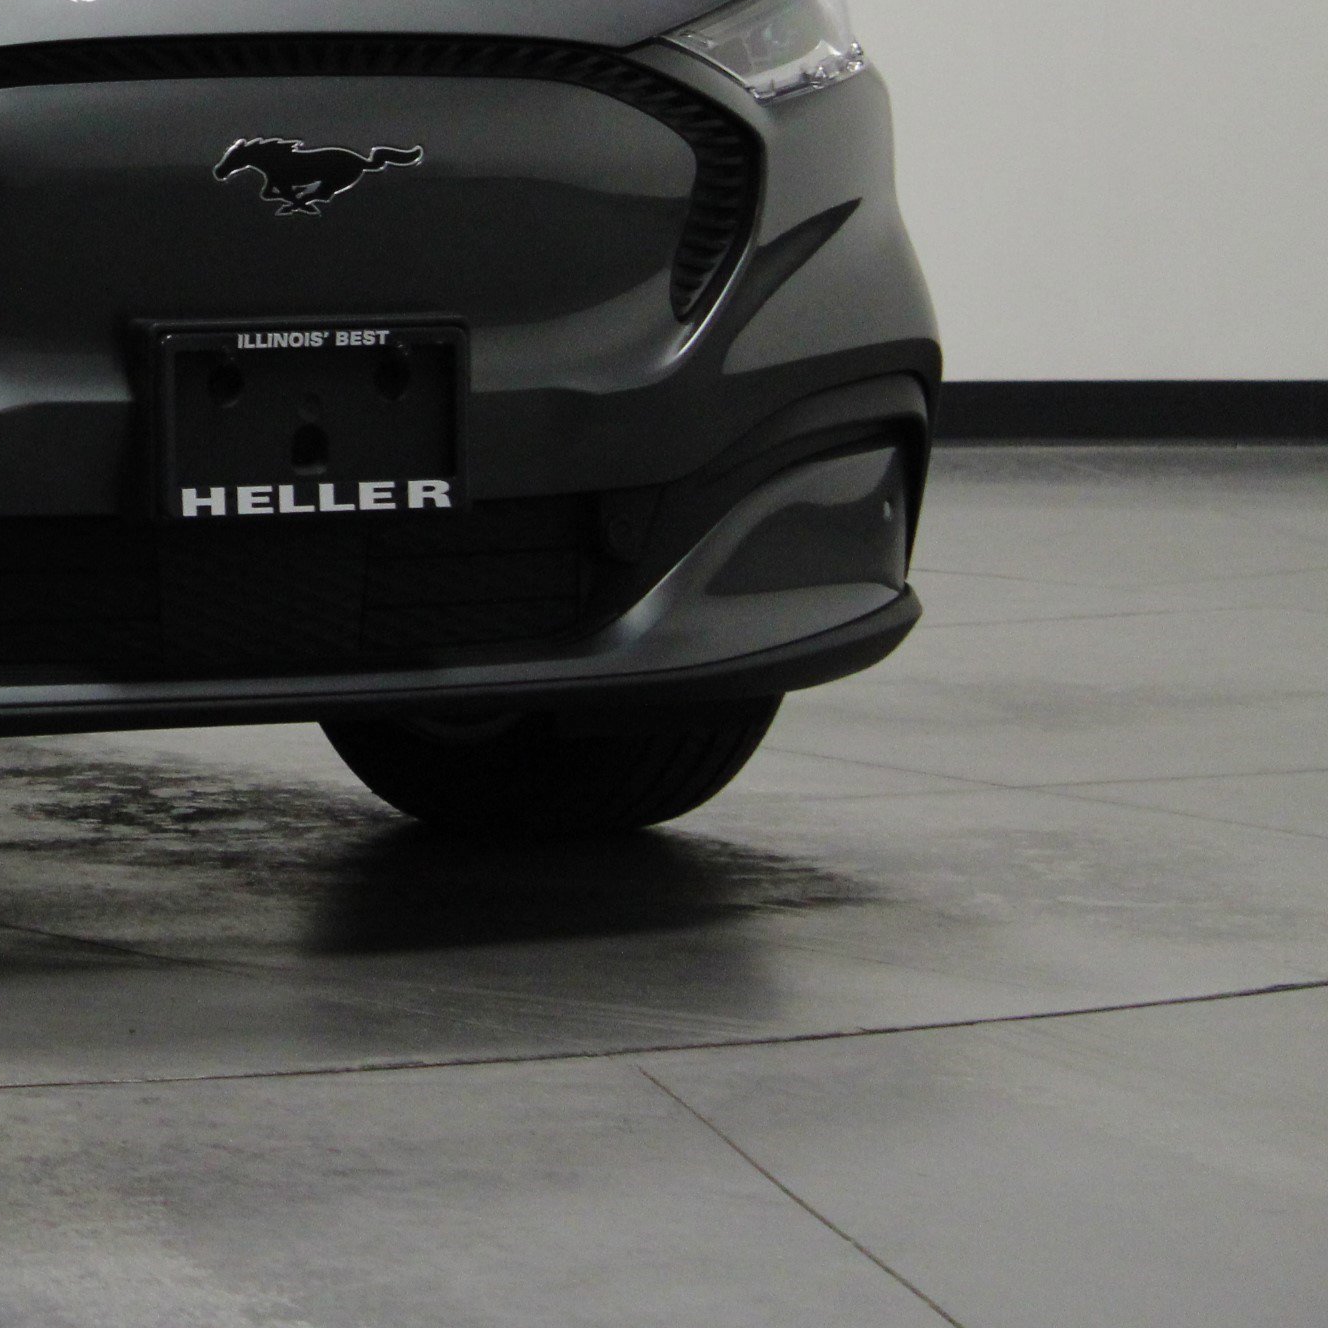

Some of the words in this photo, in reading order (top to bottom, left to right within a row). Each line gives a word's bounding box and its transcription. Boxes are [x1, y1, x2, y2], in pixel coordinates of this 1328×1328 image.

[237, 331, 330, 350] ILLINOIS'
[335, 329, 390, 347] BEST
[180, 478, 452, 518] HELLER
